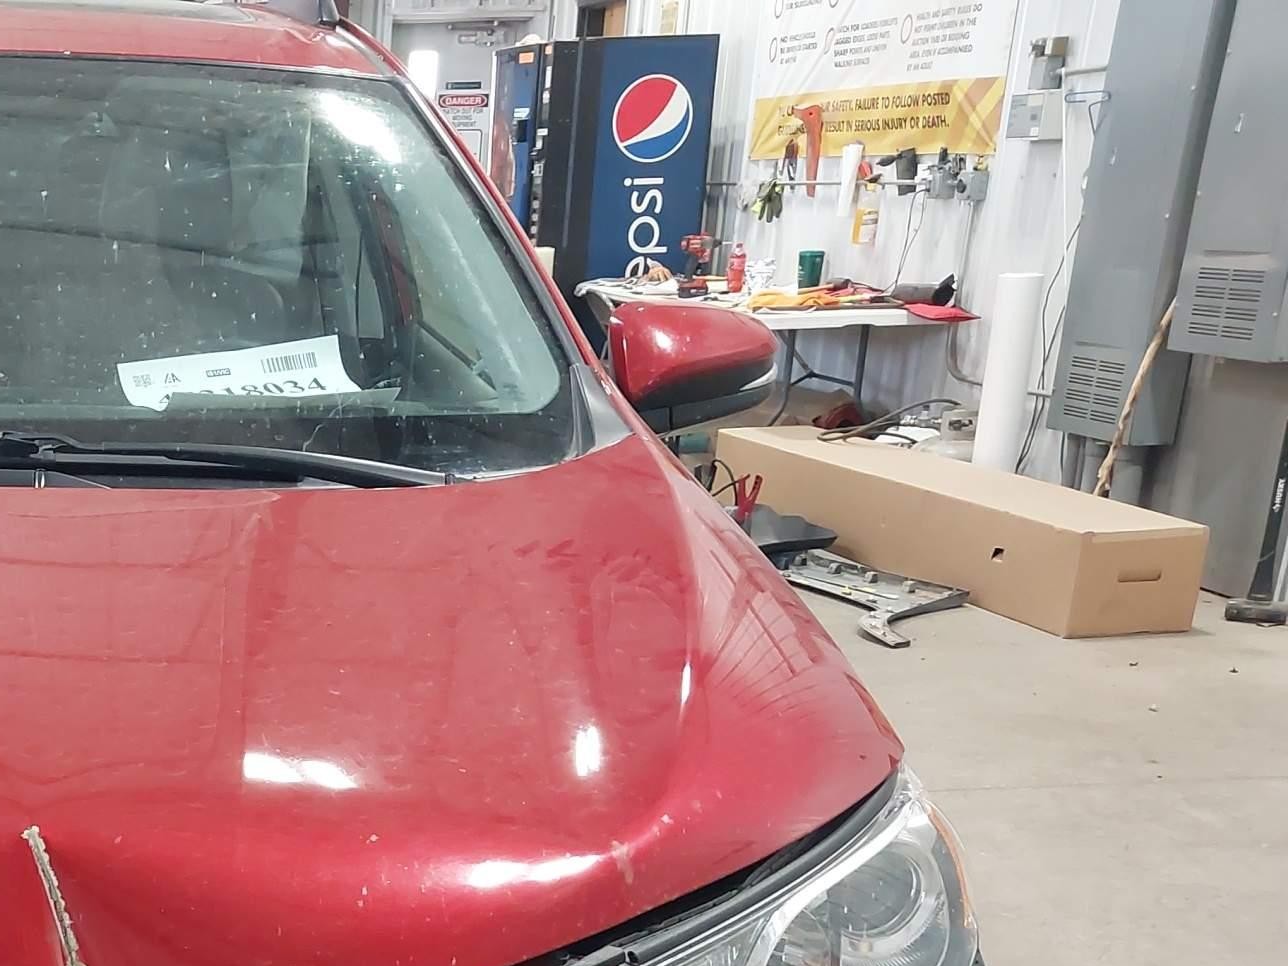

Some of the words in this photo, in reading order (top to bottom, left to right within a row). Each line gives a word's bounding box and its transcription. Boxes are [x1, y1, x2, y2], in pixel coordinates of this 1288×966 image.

[445, 95, 482, 105] DANGER
[854, 97, 880, 111] FAILURE
[881, 96, 890, 109] TO
[891, 94, 921, 108] FOLLOW
[921, 92, 951, 107] POSTED
[854, 119, 881, 132] SERIOUS
[881, 116, 908, 130] INJURY
[909, 116, 920, 129] OR
[921, 114, 950, 128] DEATH.
[623, 176, 668, 280] epsi
